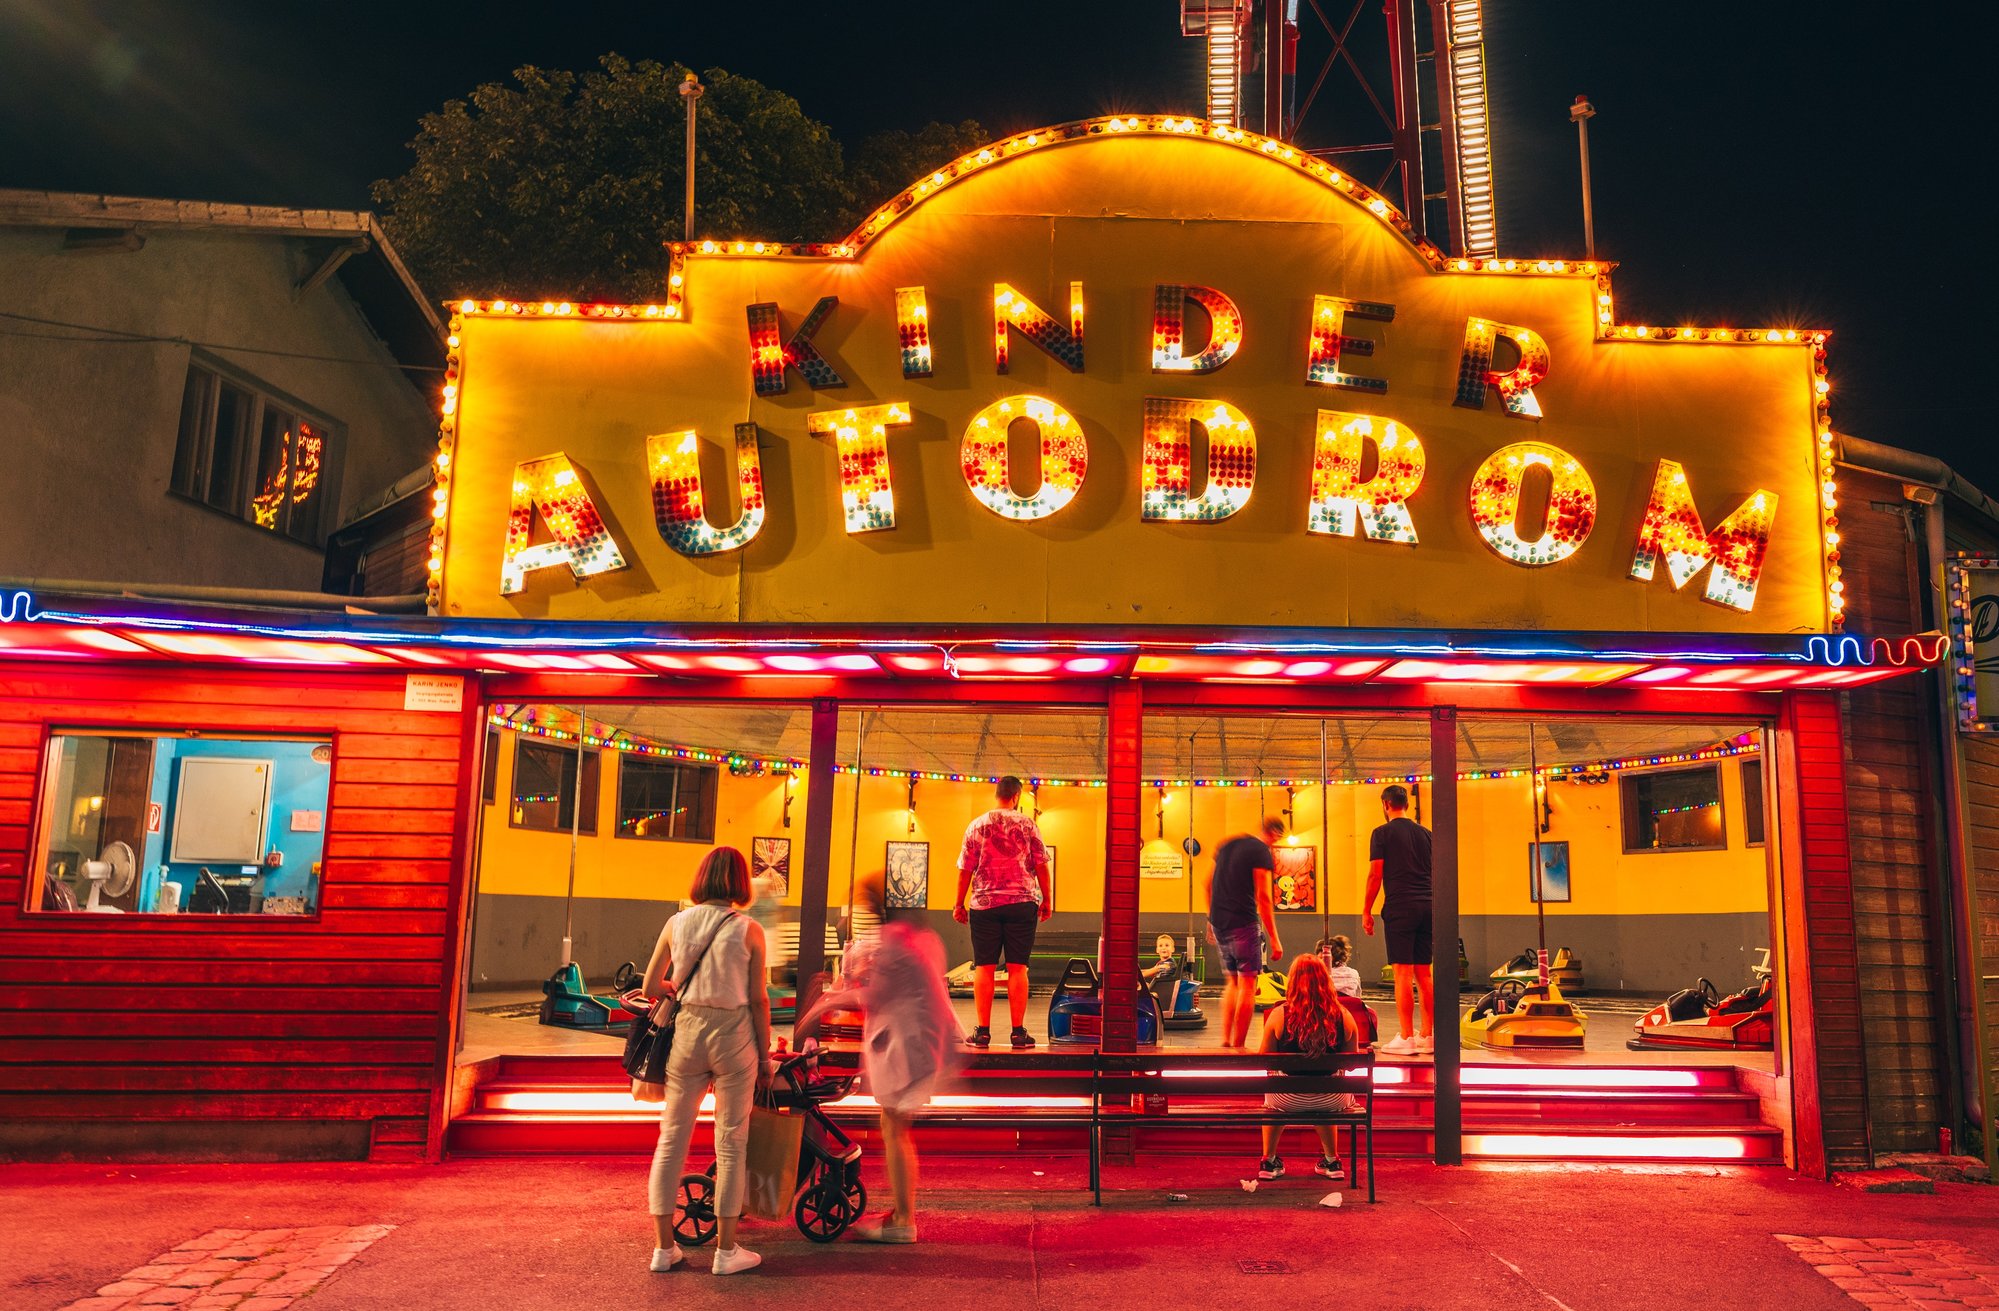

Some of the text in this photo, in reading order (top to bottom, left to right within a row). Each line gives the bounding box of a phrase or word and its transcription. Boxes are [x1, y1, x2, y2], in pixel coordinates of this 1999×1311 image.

[746, 281, 1551, 422] KINDER
[499, 394, 1780, 613] AUTODROM
[436, 681, 458, 689] JENKO
